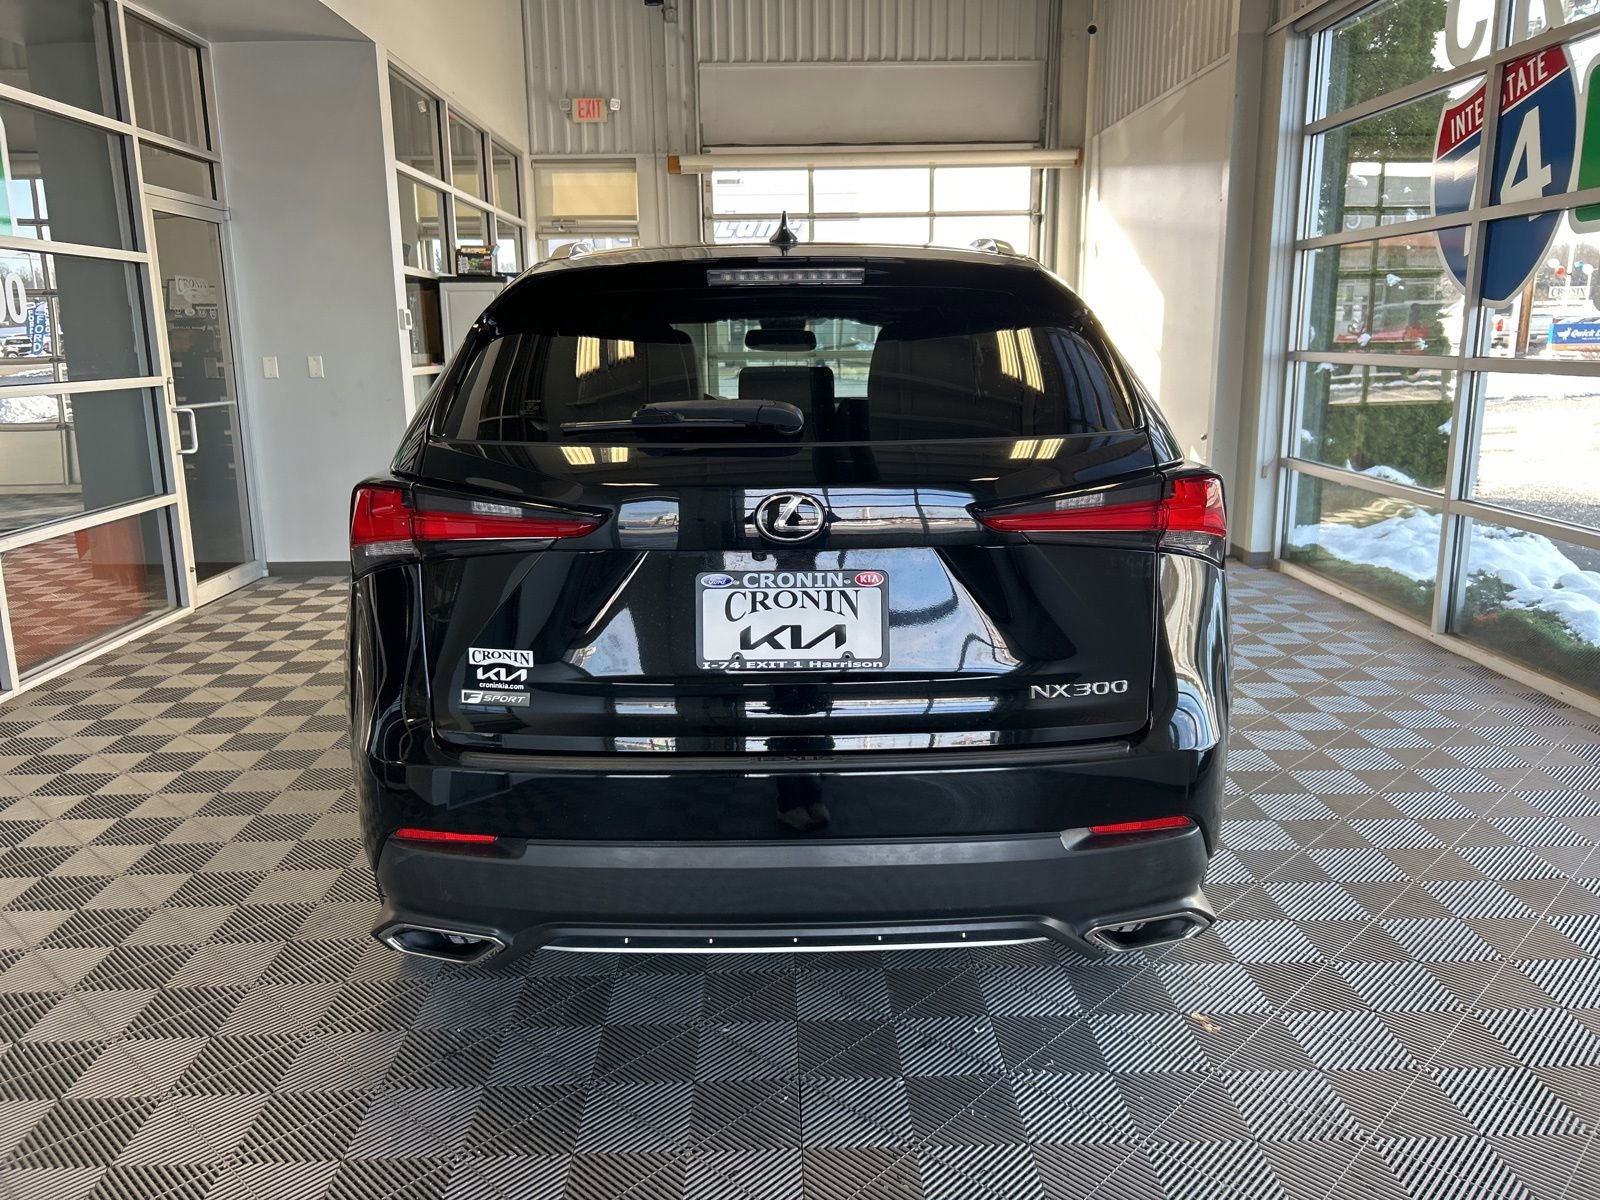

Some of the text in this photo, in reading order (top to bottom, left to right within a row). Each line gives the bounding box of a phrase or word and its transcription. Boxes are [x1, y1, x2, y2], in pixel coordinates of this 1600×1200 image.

[1451, 52, 1549, 144] INTETATE
[577, 99, 601, 119] EXIT
[1551, 287, 1586, 298] CRNIN
[34, 315, 45, 352] FORD
[742, 573, 843, 588] CRONIN
[860, 575, 880, 584] KIA
[724, 589, 861, 623] CRONIN
[471, 649, 531, 666] CRONIN
[702, 659, 884, 670] I-74 EXIT 1 Harrison
[479, 682, 525, 690] croninkia.com
[483, 694, 527, 703] SPORT
